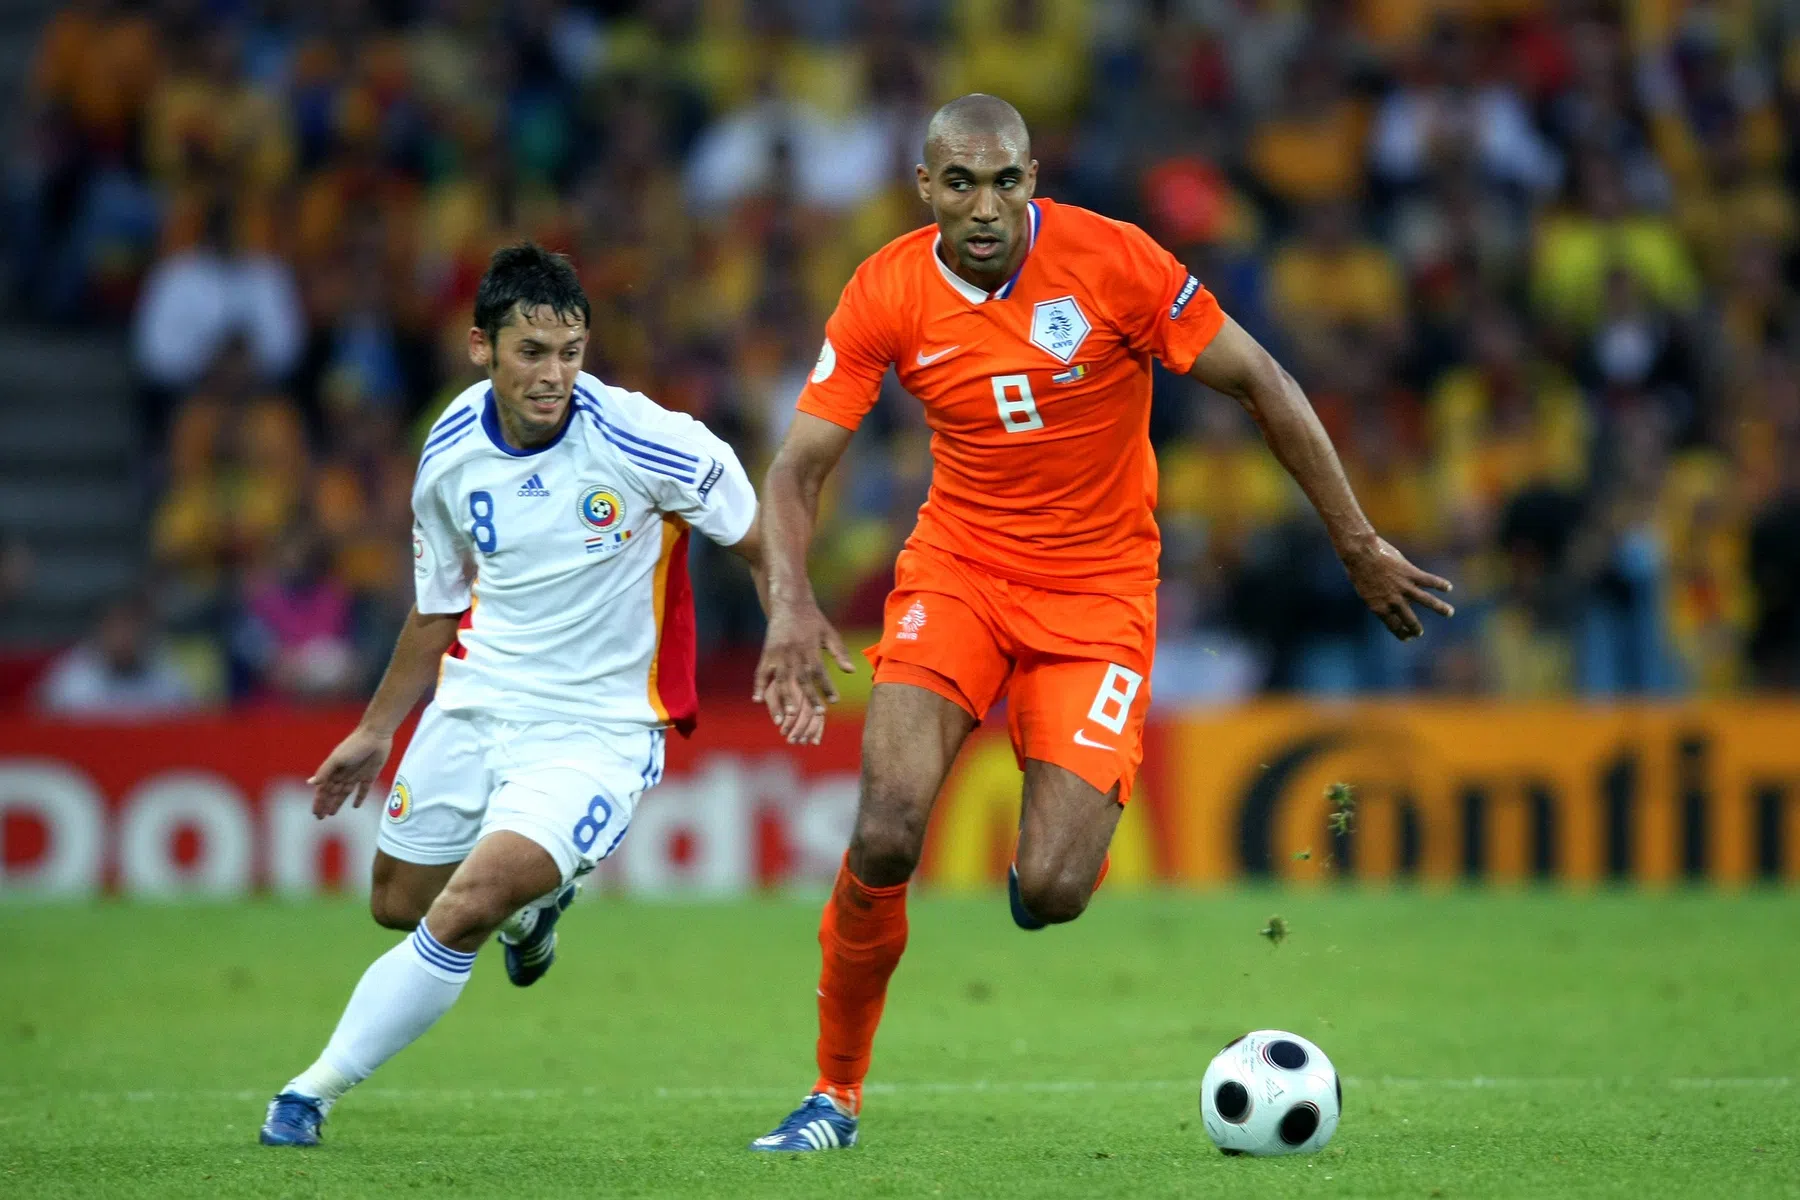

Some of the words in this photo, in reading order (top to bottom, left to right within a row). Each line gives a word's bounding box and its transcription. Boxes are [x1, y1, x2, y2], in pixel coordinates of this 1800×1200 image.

[1176, 274, 1199, 305] RESPE
[991, 374, 1045, 433] 8
[470, 491, 497, 552] 8
[517, 488, 550, 497] adidas
[1087, 662, 1144, 735] 8
[573, 794, 612, 854] 8
